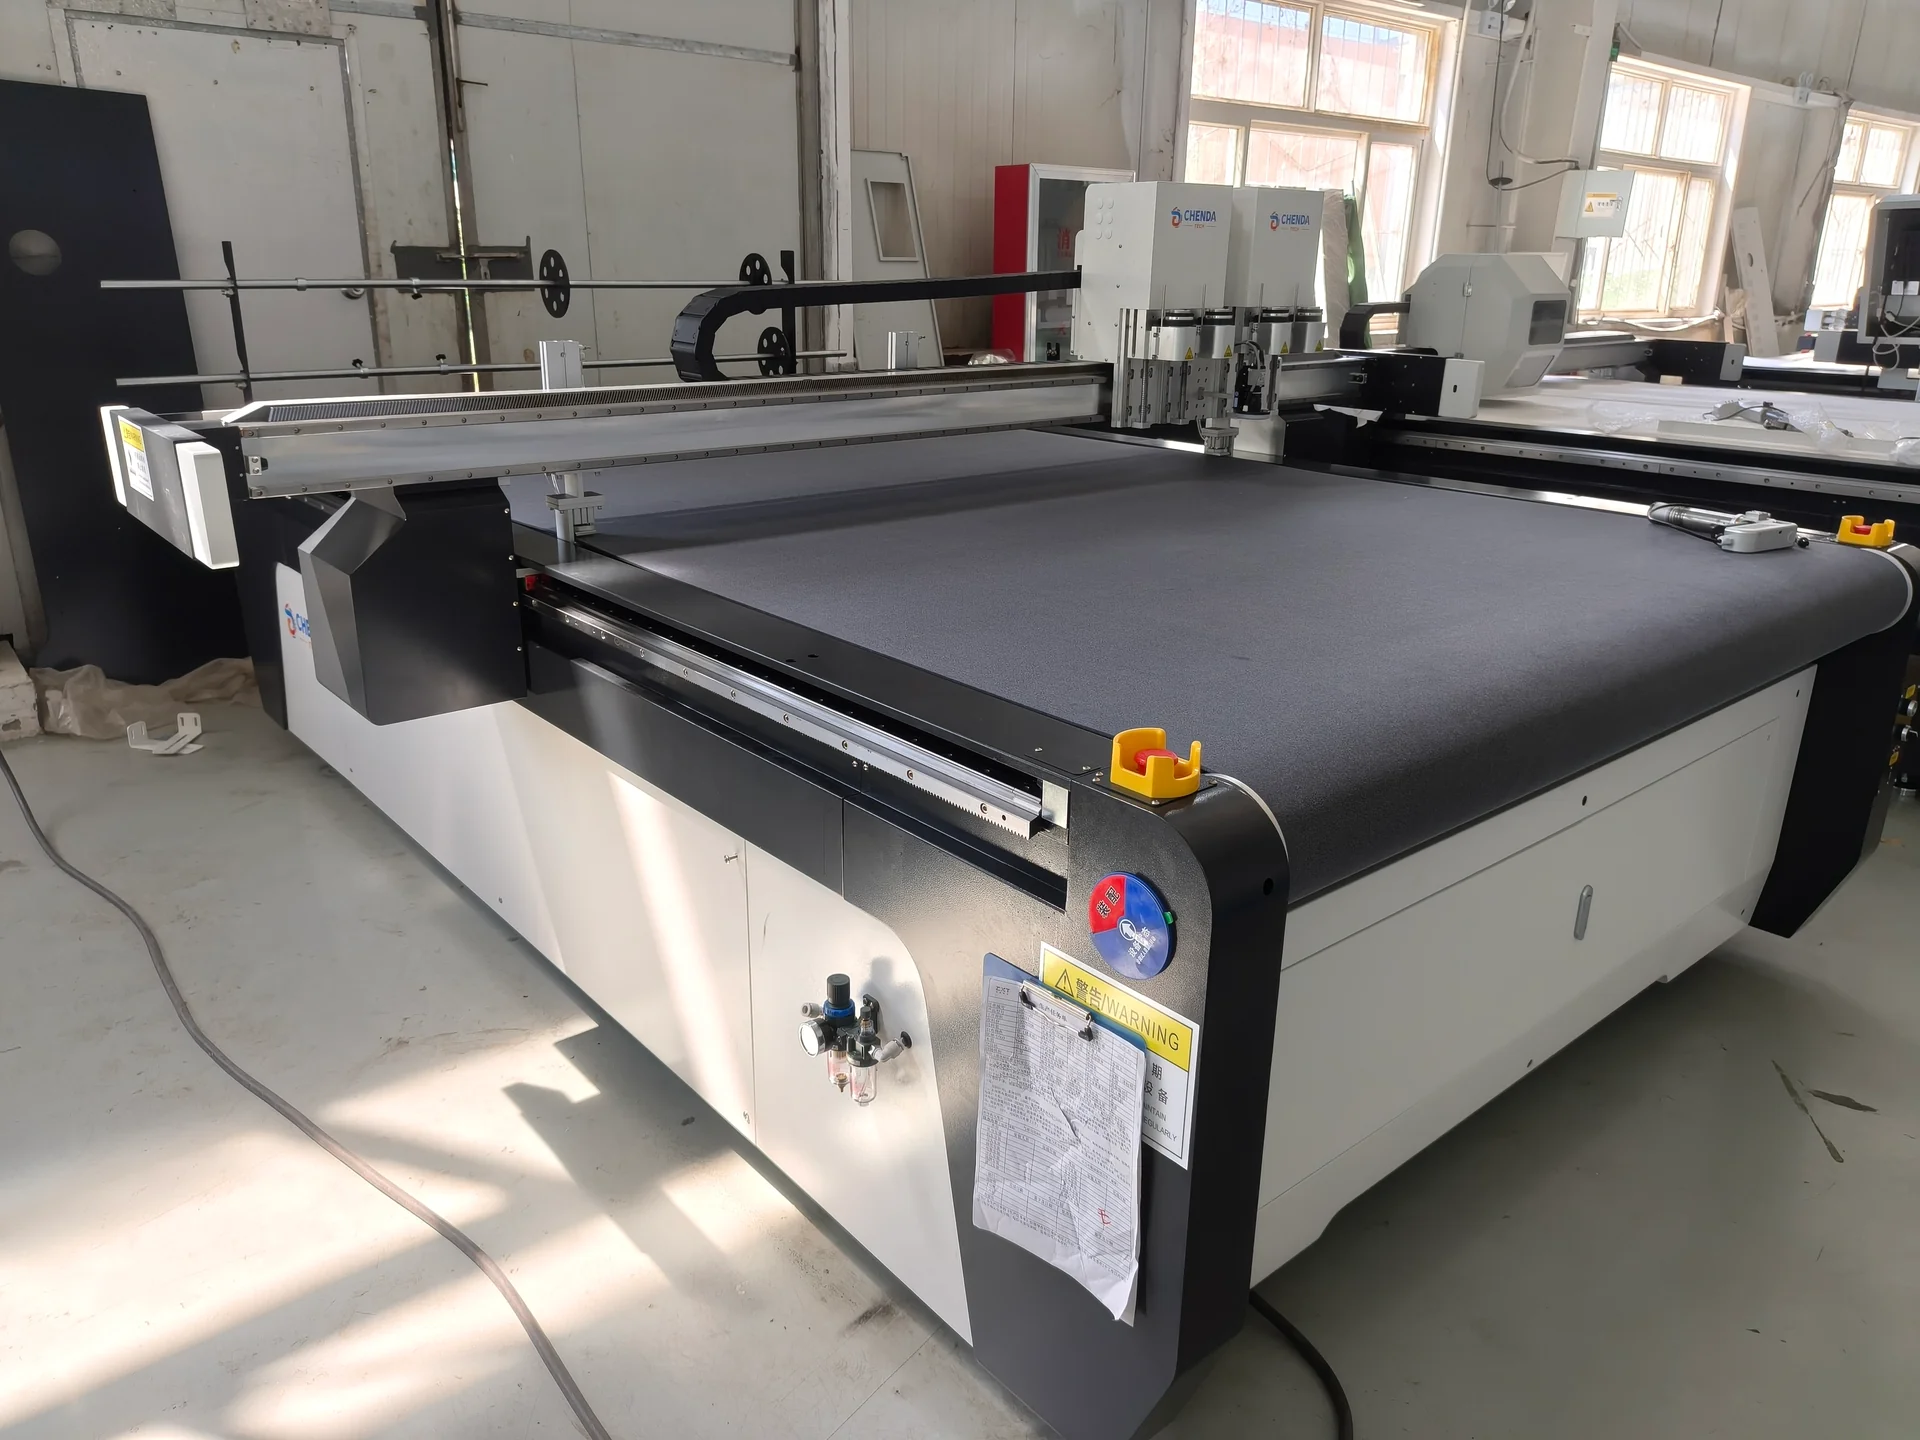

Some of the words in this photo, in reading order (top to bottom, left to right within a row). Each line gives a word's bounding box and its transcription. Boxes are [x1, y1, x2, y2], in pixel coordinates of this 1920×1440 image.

[1184, 210, 1217, 222] CHENDA
[1281, 214, 1310, 225] CHENDA
[296, 613, 311, 637] CHE
[1127, 926, 1151, 958] 设备态
[1143, 1115, 1178, 1142] EGULARLY
